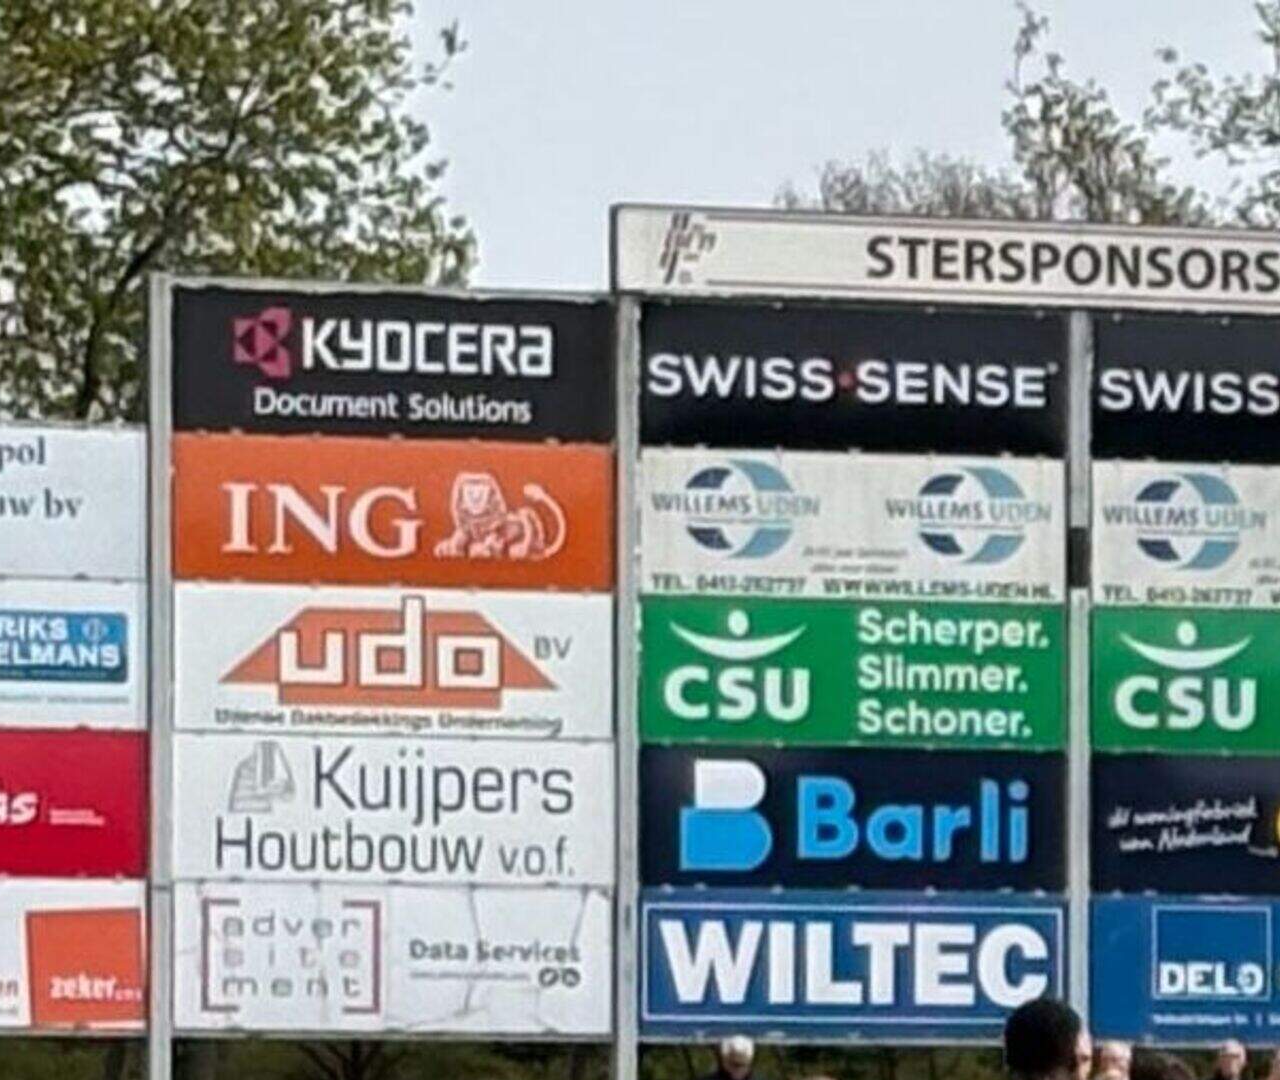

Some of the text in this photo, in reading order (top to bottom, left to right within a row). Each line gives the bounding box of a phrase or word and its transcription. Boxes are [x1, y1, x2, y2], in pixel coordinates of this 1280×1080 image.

[302, 318, 553, 376] KYOCERA
[648, 354, 835, 400] SWISS
[1100, 369, 1280, 415] SWISS
[253, 388, 532, 423] Document Solutions
[44, 488, 84, 519] bv
[221, 482, 423, 558] ING
[651, 493, 821, 518] WILLEMS UDEN
[885, 500, 1053, 523] WILLEMS UDEN
[1101, 506, 1267, 530] WILLEMS UDEN
[533, 636, 573, 661] BV
[857, 608, 1049, 655] Scherper.
[662, 665, 811, 722] CSU
[857, 655, 1029, 693] Slimmer.
[857, 699, 1033, 738] Schoner.
[1113, 675, 1256, 731] CSU
[312, 745, 575, 827] Kuijpers
[796, 775, 1030, 862] Barli
[214, 816, 484, 874] Houtbouw
[409, 938, 581, 963] Data Services
[658, 919, 1049, 1009] WILTEC
